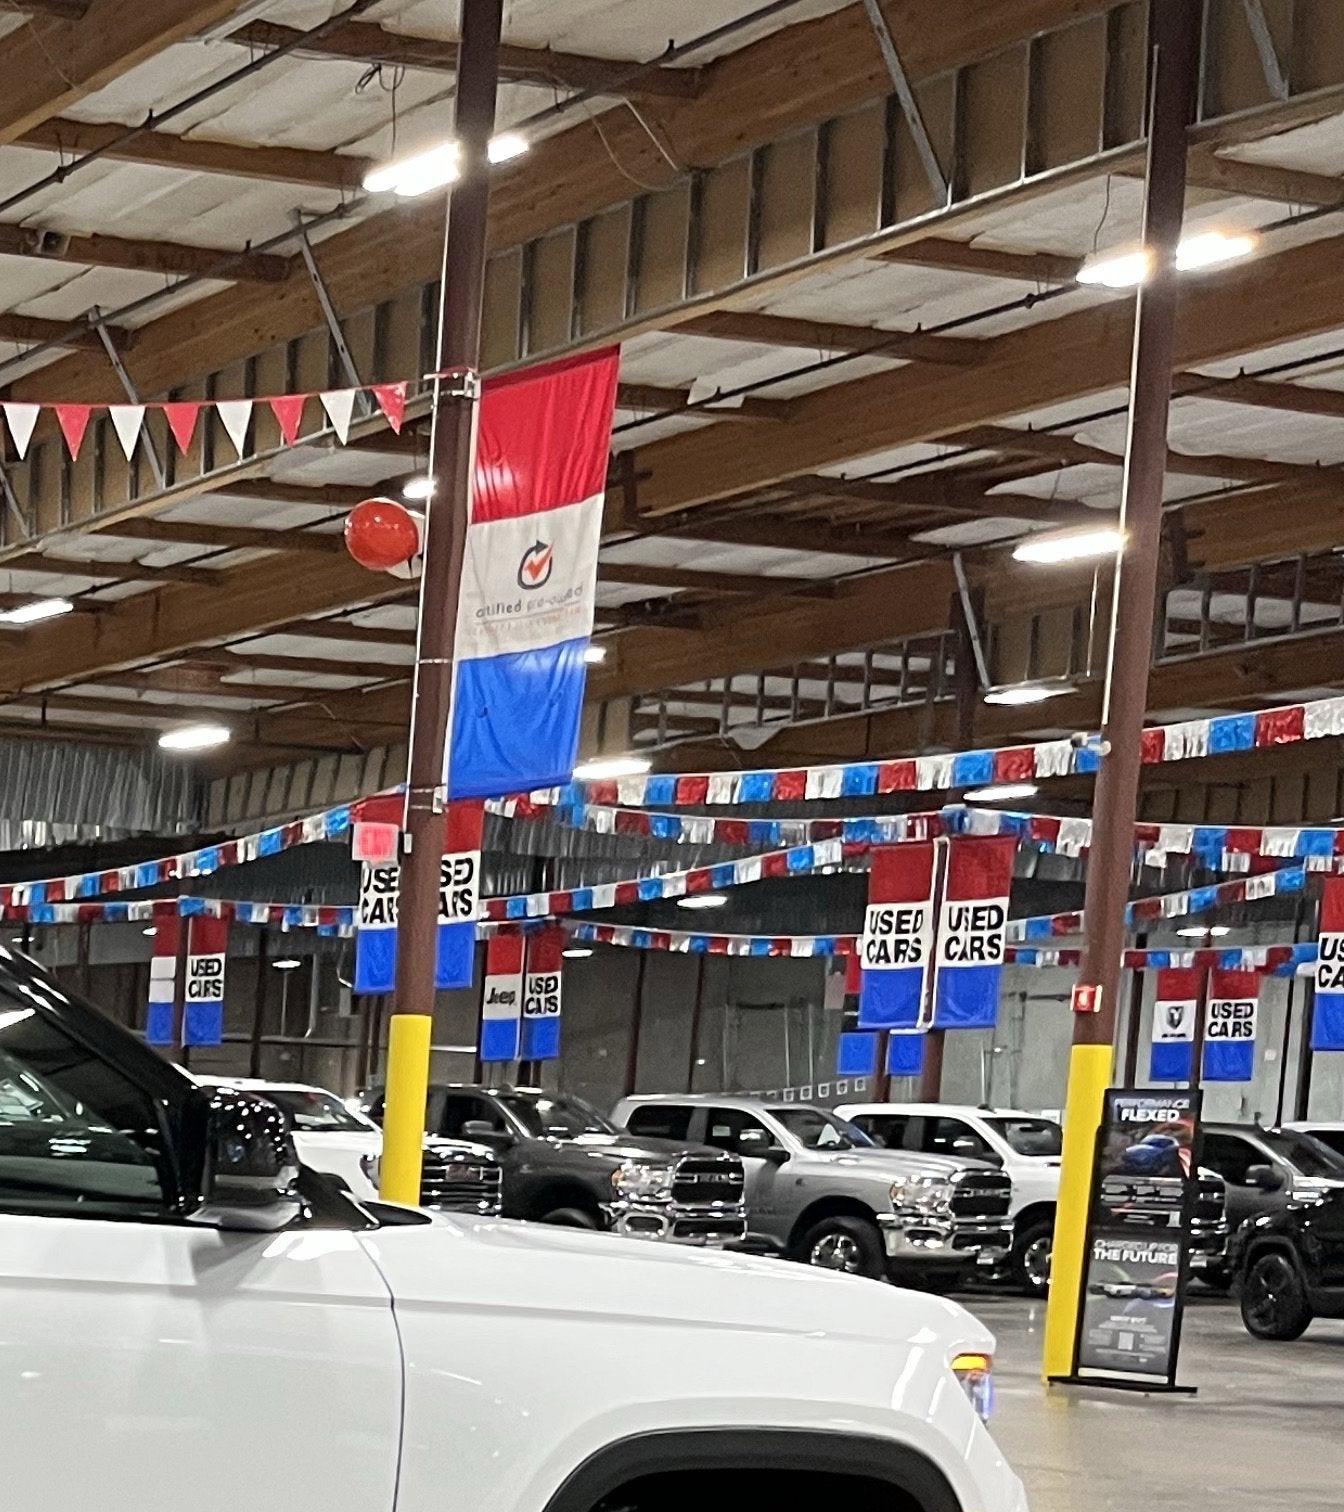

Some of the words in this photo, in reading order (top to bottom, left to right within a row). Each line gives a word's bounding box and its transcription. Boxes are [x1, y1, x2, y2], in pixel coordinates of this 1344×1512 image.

[362, 866, 398, 894] USE
[440, 857, 474, 888] SED
[440, 888, 473, 918] ARS
[869, 909, 924, 935] USED
[948, 904, 1004, 933] USED
[866, 937, 922, 964] CARS
[944, 933, 1002, 961] CARS
[191, 958, 222, 977] USED
[188, 978, 223, 998] CARS
[529, 975, 559, 995] USED
[525, 995, 558, 1015] CARS
[1211, 1002, 1254, 1019] USED
[1207, 1021, 1253, 1037] CARS
[1121, 1108, 1180, 1122] FLEXED
[1093, 1247, 1120, 1261] THE
[1122, 1250, 1178, 1265] FUTURE
